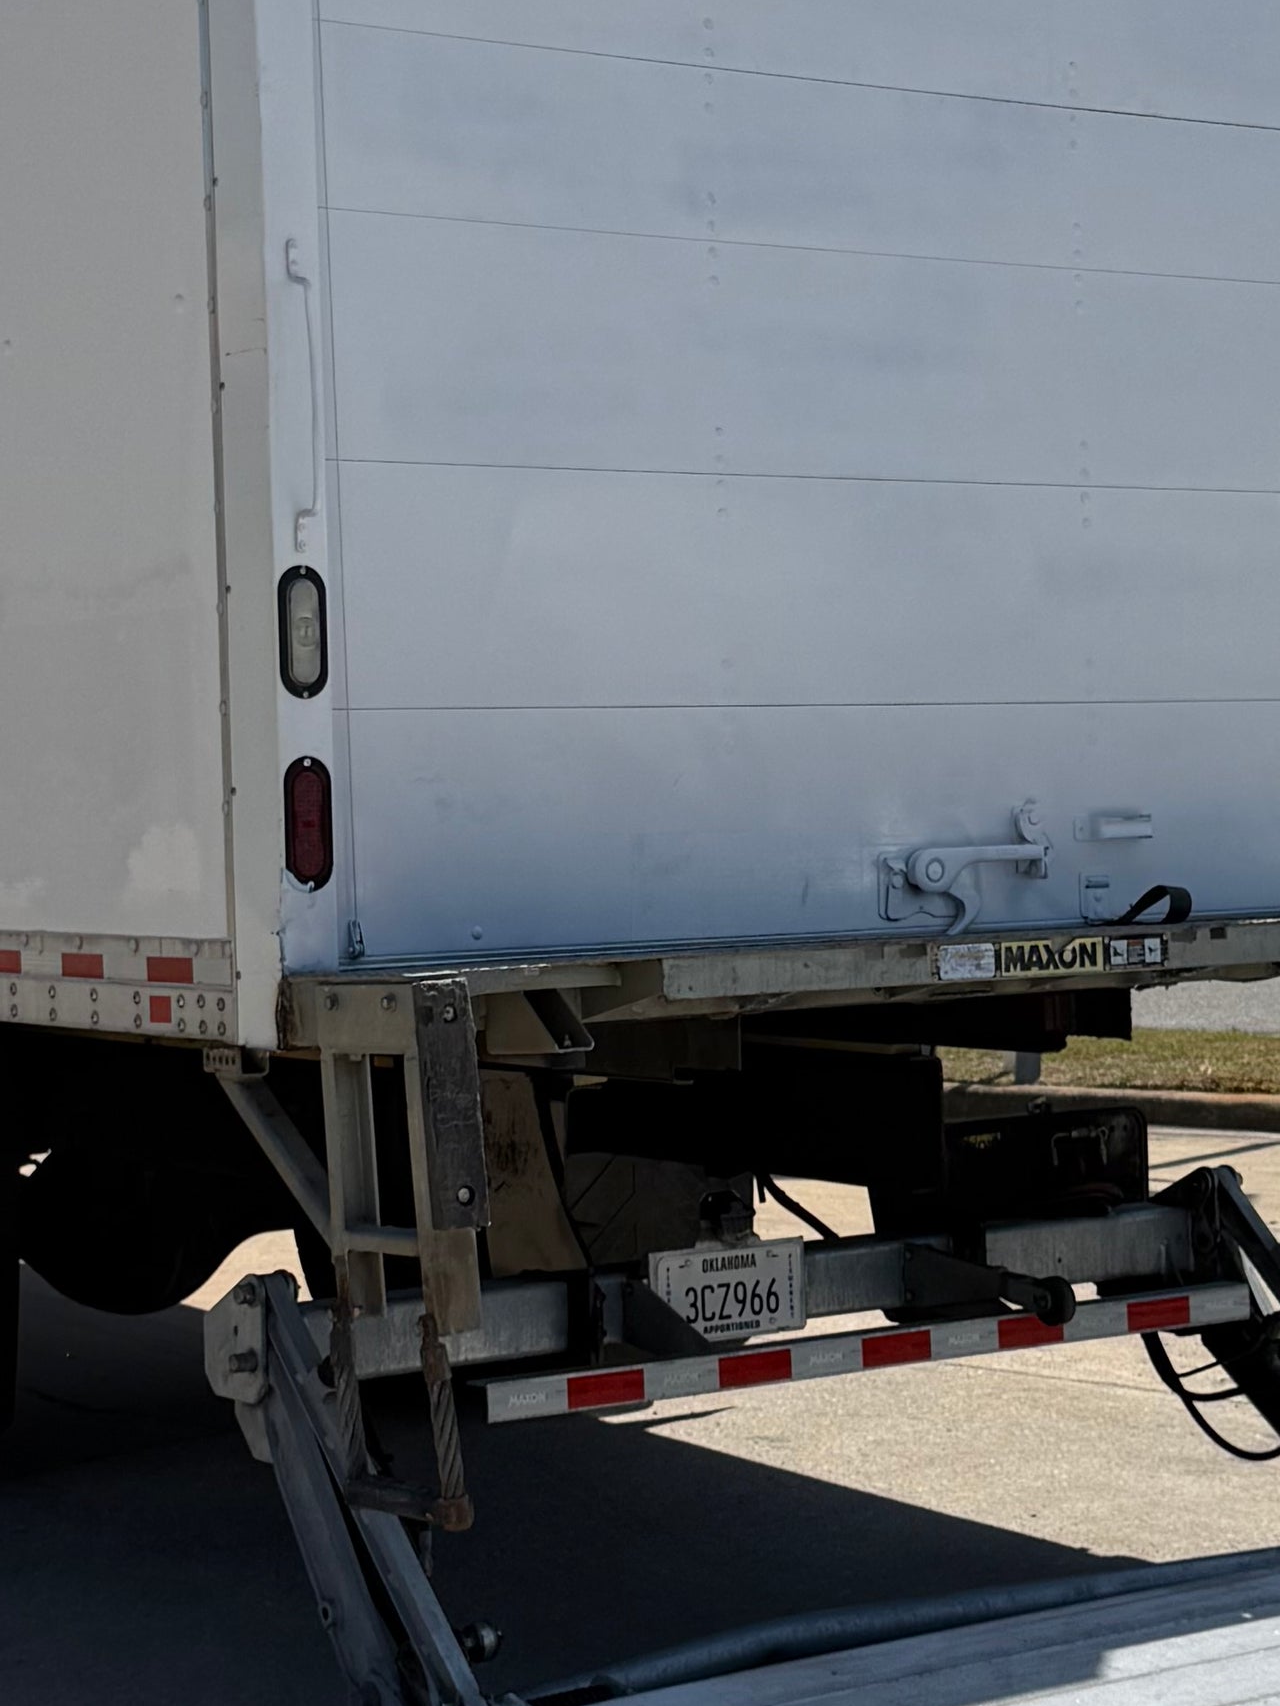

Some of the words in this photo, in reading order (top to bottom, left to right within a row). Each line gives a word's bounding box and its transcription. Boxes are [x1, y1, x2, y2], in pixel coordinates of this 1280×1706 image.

[1003, 942, 1098, 973] MAXON
[702, 1253, 757, 1273] OKLAHOMA
[685, 1277, 780, 1324] 3CZ966
[703, 1319, 761, 1334] APPORTIONED
